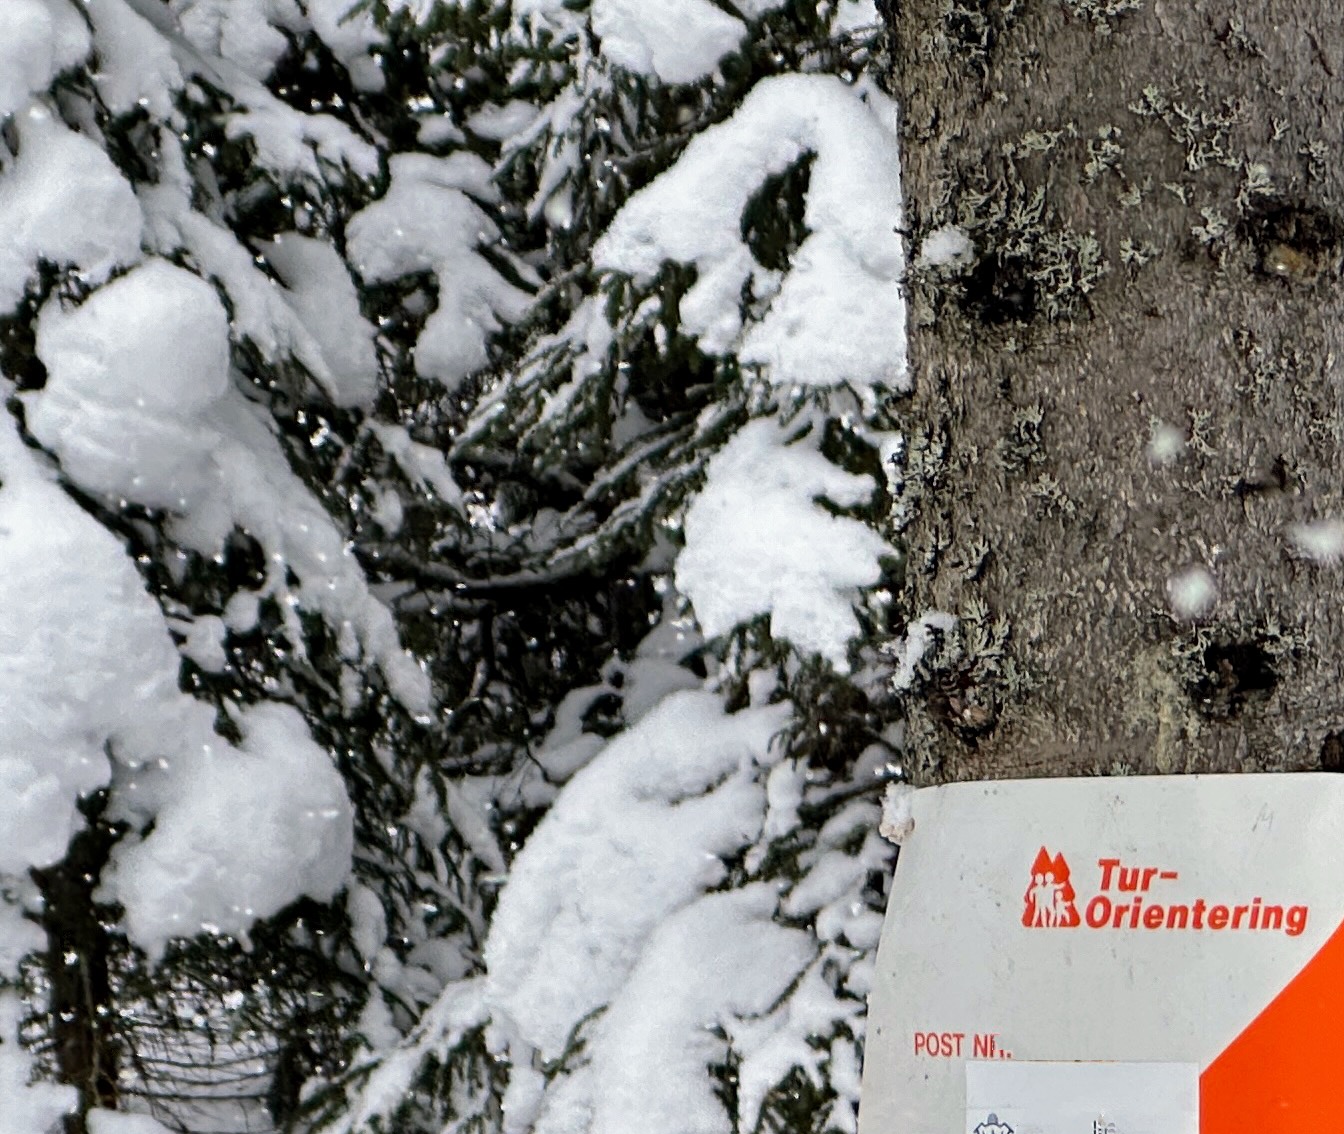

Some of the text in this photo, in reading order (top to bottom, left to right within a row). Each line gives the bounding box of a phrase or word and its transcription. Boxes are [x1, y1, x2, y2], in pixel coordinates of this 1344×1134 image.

[1097, 858, 1178, 892] Tur-
[1085, 895, 1309, 937] Orientering
[914, 1032, 964, 1058] POST
